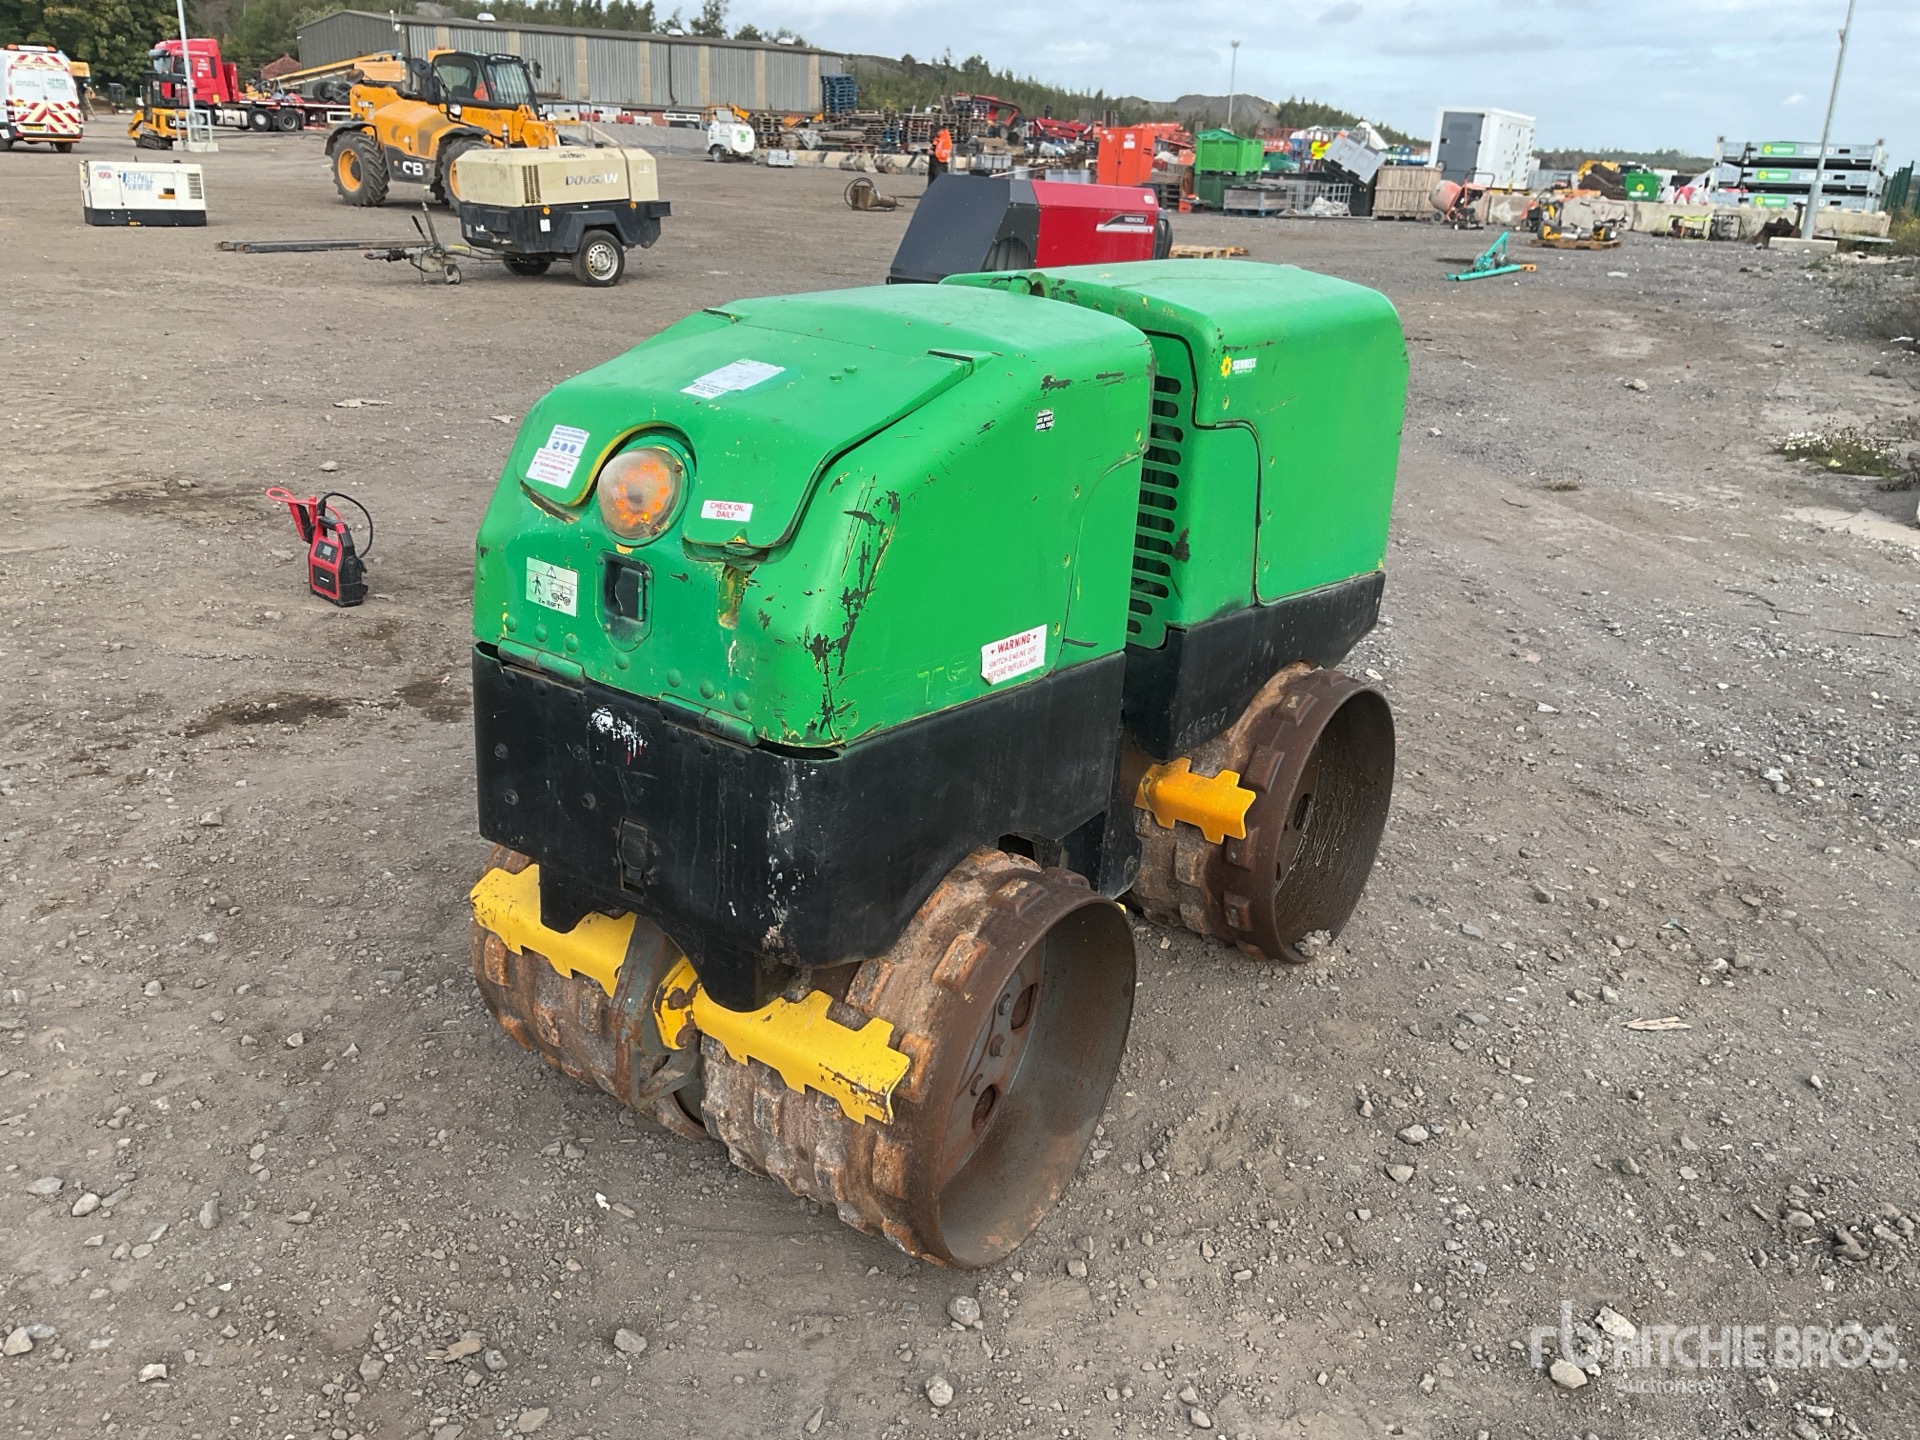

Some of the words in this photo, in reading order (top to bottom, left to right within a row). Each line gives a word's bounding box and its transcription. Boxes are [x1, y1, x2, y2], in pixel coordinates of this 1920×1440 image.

[710, 502, 732, 510] CHECK
[734, 504, 745, 512] OIL
[716, 510, 735, 518] DAILY
[998, 633, 1031, 654] WARNING
[987, 666, 1007, 679] BEFORE
[1008, 655, 1037, 672] REFUELLING
[989, 656, 1008, 669] SWITCH
[1009, 649, 1027, 662] ENGINE
[1027, 645, 1037, 655] OFF
